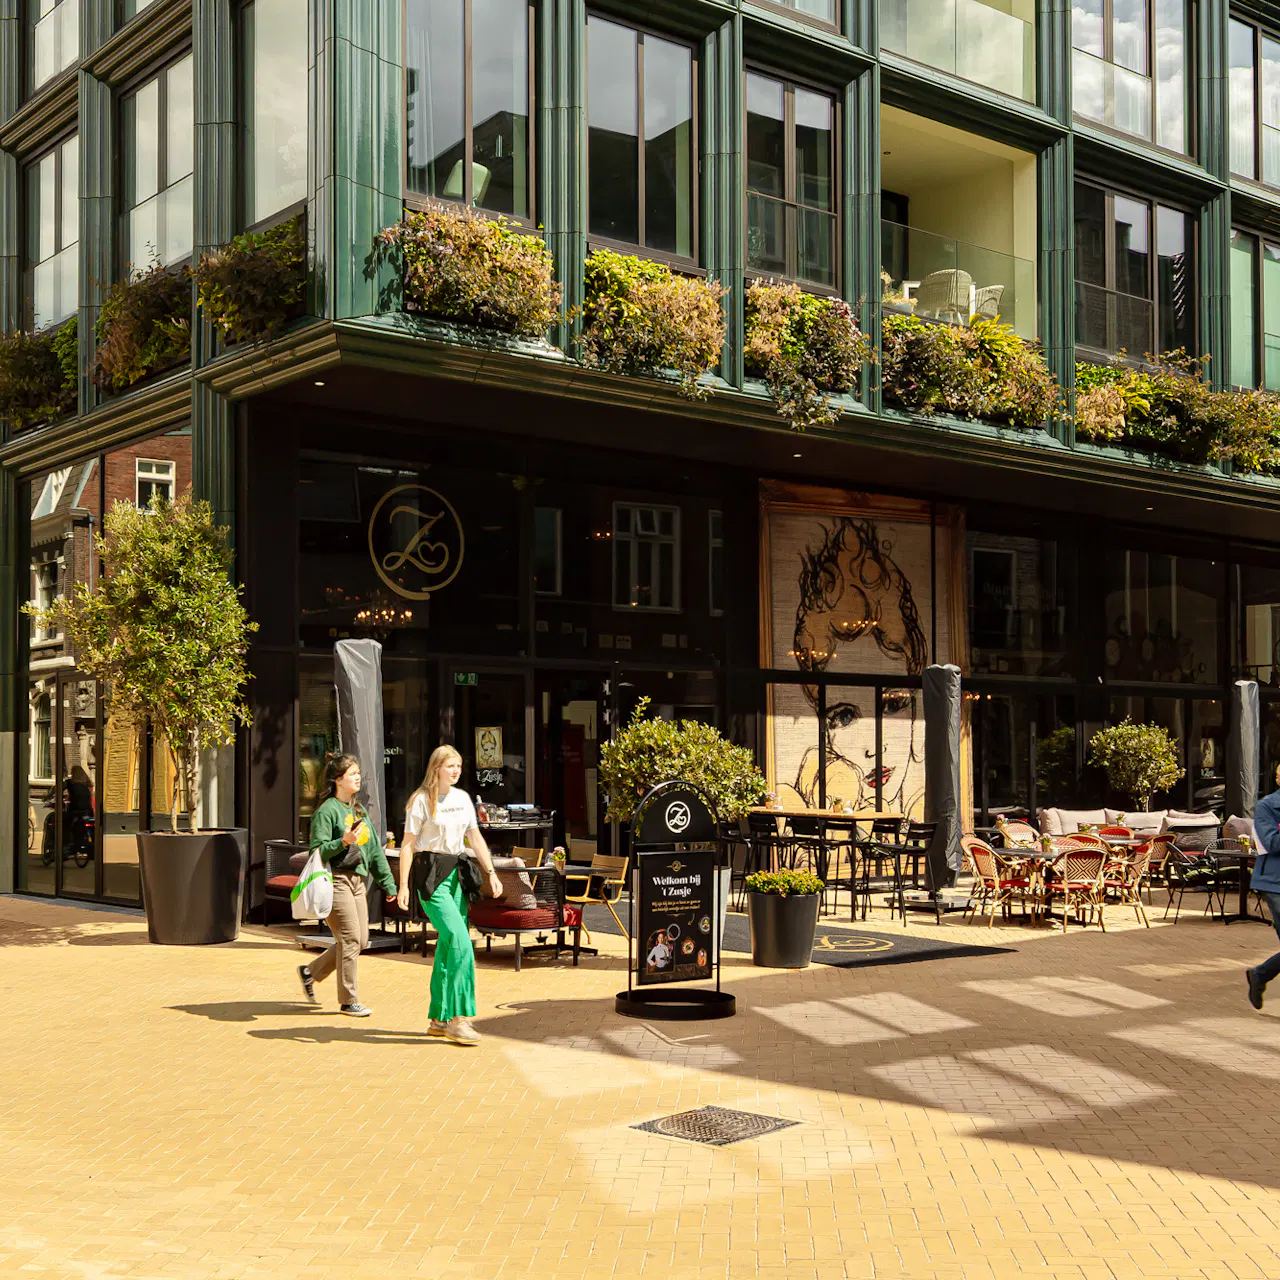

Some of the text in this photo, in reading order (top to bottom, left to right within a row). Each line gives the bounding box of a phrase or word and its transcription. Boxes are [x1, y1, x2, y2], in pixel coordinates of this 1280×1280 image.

[652, 874, 701, 887] Welkom bij
[668, 886, 692, 898] Zusje
